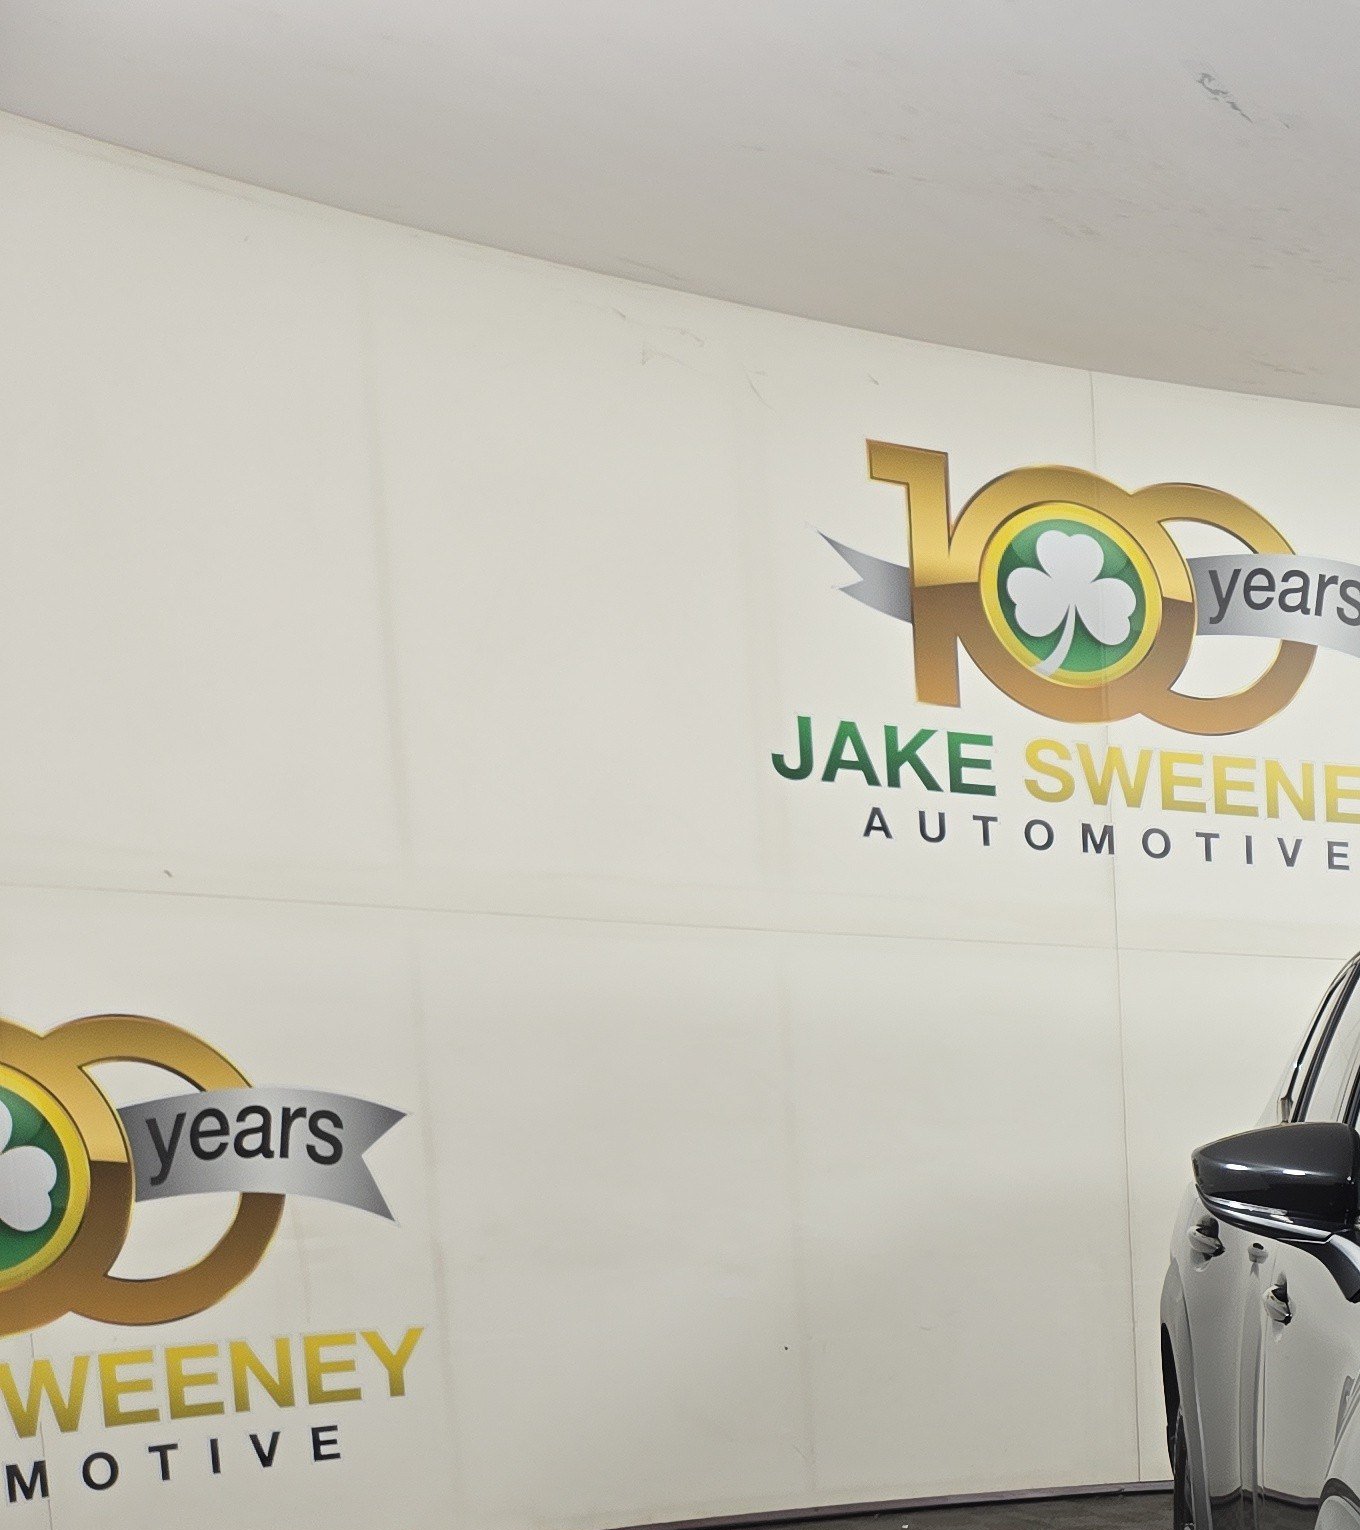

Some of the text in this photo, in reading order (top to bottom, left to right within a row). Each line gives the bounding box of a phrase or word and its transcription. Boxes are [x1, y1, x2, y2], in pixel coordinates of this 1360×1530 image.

[866, 438, 1319, 737] 100
[771, 715, 997, 797] JAKE
[863, 806, 1352, 872] AUTOMOTIVE
[144, 1104, 345, 1186] years
[6, 1426, 341, 1502] MOTIVE
